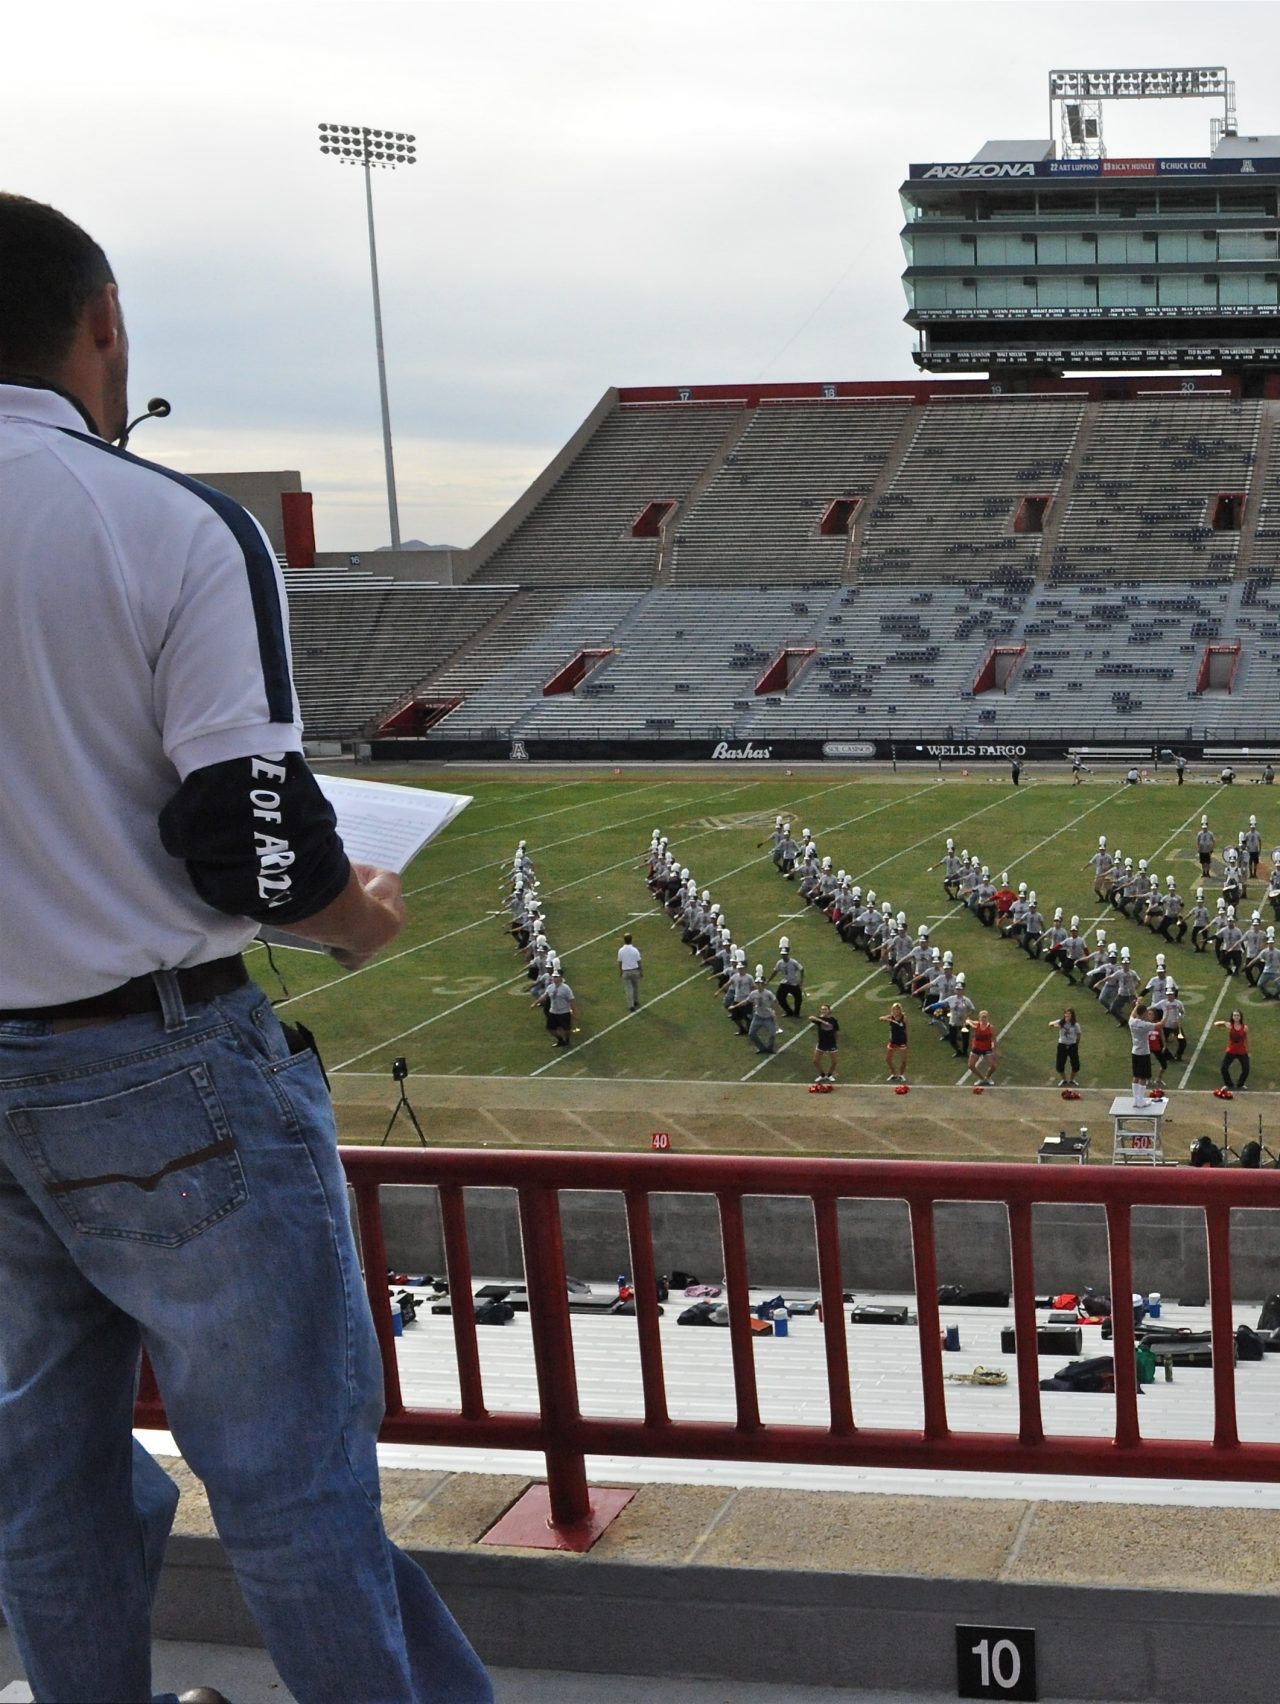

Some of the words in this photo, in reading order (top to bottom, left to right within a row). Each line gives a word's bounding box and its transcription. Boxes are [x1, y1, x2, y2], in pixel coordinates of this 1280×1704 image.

[922, 163, 1036, 179] ARIZONA
[1051, 163, 1059, 172] 22
[1059, 164, 1071, 172] ART
[1072, 163, 1099, 172] LUPPINO
[1189, 162, 1208, 170] CECIL
[824, 388, 835, 398] 18
[991, 385, 1002, 395] 19
[1181, 382, 1195, 393] 20
[679, 392, 690, 401] 17
[711, 742, 773, 759] Bashas'
[928, 745, 976, 756] WELLS
[977, 745, 1026, 756] FARGO
[250, 789, 282, 825] OF
[253, 831, 296, 908] ARIZ
[653, 1134, 668, 1149] 40
[1134, 1136, 1148, 1149] 50
[971, 1639, 1021, 1689] 10
